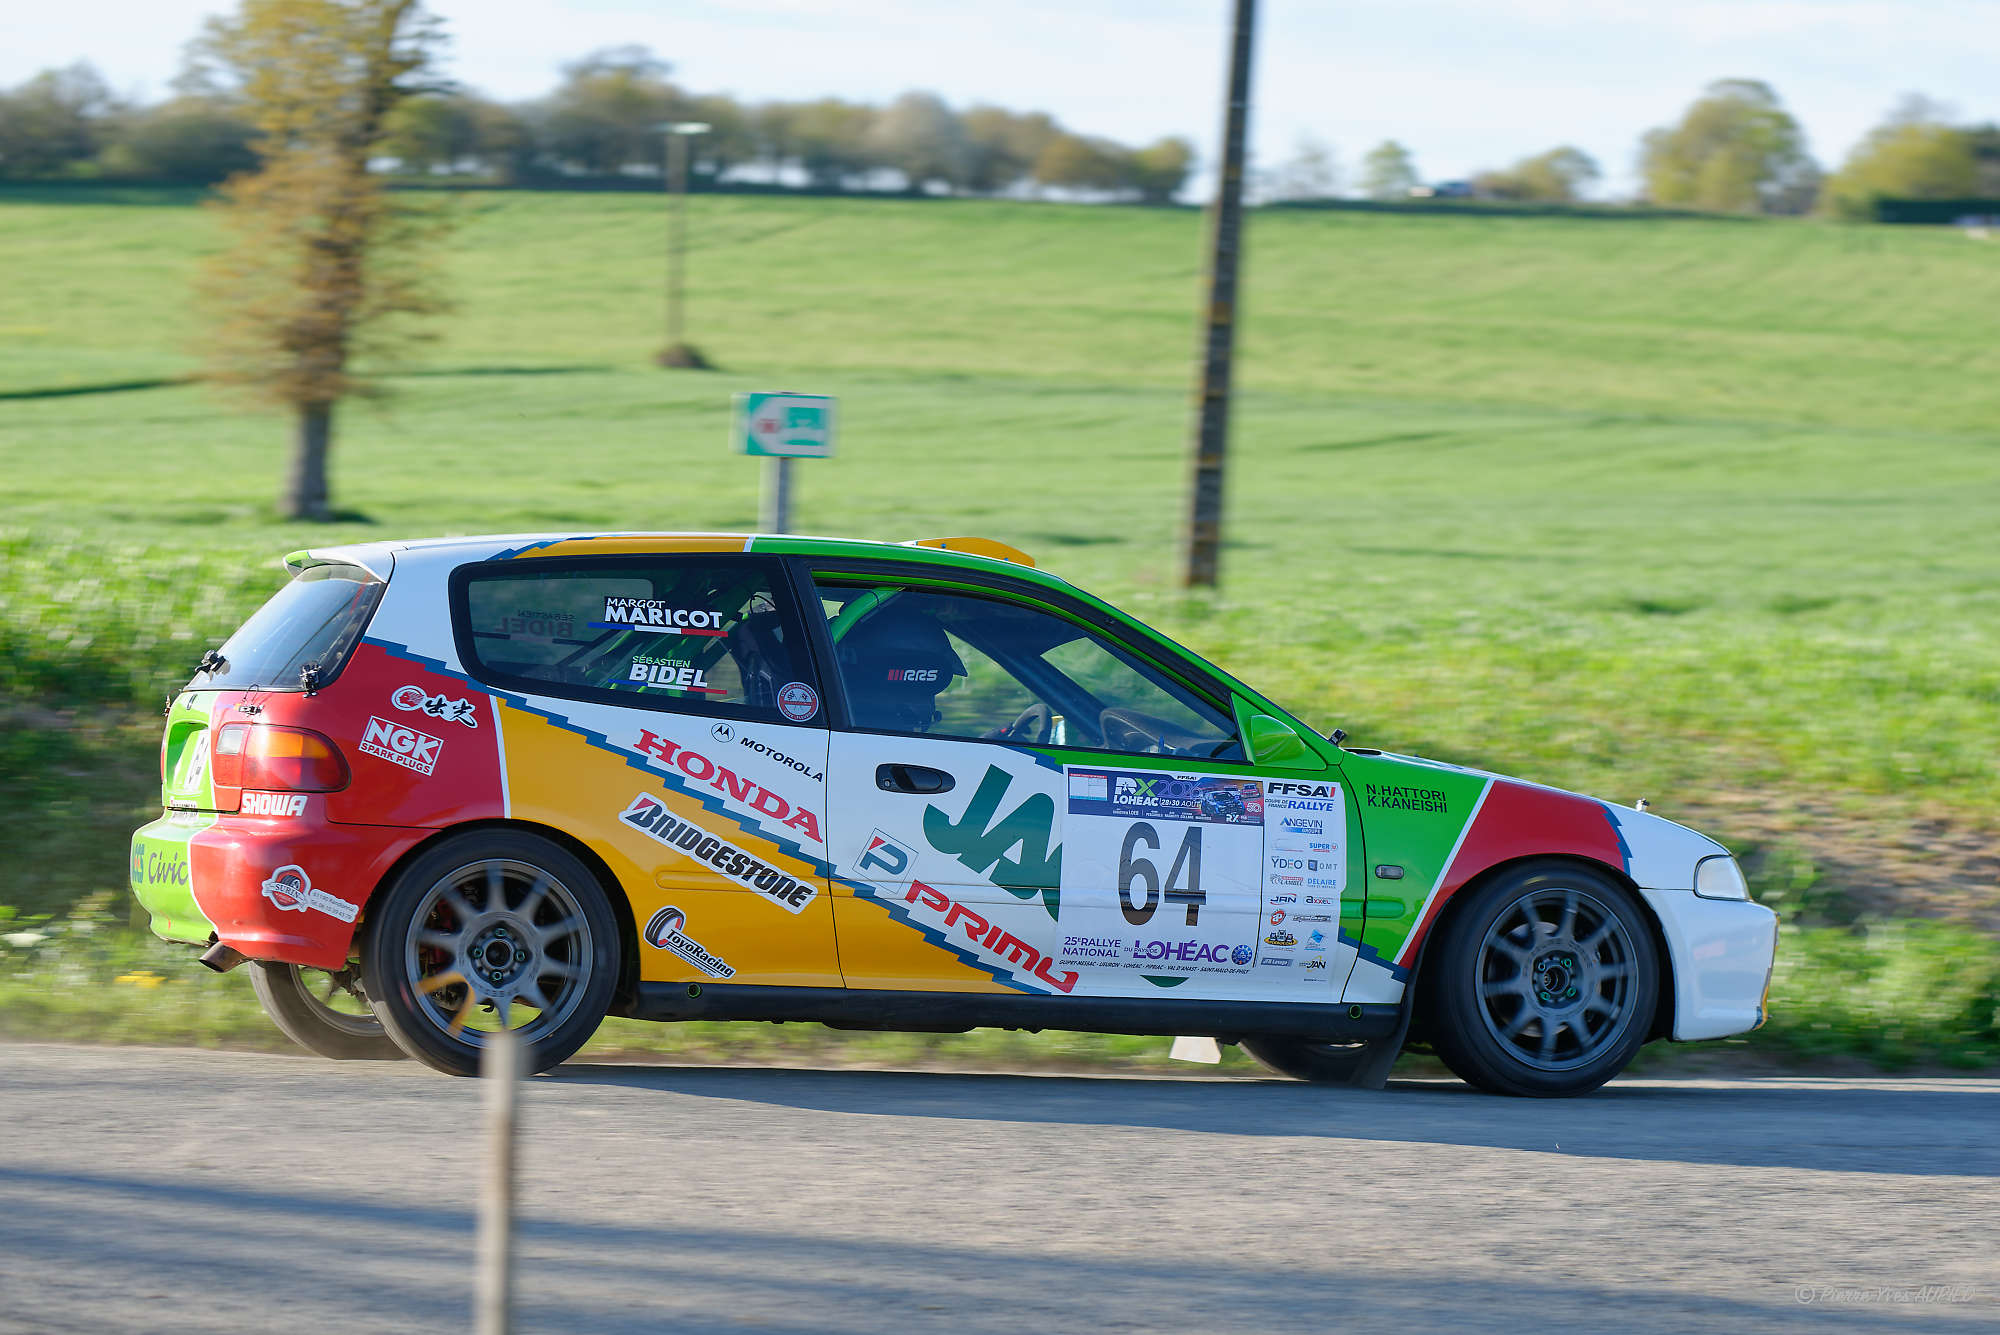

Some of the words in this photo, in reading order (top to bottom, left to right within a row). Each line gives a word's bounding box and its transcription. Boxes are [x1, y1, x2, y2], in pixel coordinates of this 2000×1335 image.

[607, 598, 666, 609] MARGOT
[604, 606, 723, 629] MARICOT
[632, 655, 691, 668] SÉBASTIEN
[629, 664, 708, 688] BIDEL
[903, 669, 938, 681] RRS
[365, 719, 440, 764] NGK
[361, 742, 395, 761] SPARK
[395, 754, 432, 774] PLUGS
[740, 737, 823, 783] MOTOROLA
[633, 728, 823, 844] HONDA
[1115, 777, 1158, 798] RX
[1267, 782, 1329, 798] FFSA
[1366, 783, 1446, 802] N.HATTORI
[241, 793, 308, 816] SHOWA
[1113, 795, 1159, 807] LOHEAC
[1288, 800, 1334, 812] RALLYE
[1367, 795, 1447, 813] K.KANEISHI
[1280, 816, 1323, 828] ANGEVIN
[625, 797, 813, 908] BRIDGESTONE
[1309, 842, 1330, 850] SUPER
[148, 850, 189, 885] Civic
[1118, 821, 1207, 927] 64
[1307, 878, 1337, 886] DELAIRE
[1270, 896, 1297, 904] JAN
[666, 928, 735, 977] ToyoRacing
[1062, 947, 1120, 958] NATIONAL
[1133, 939, 1230, 964] LOHÉAC
[1306, 960, 1327, 969] JAN
